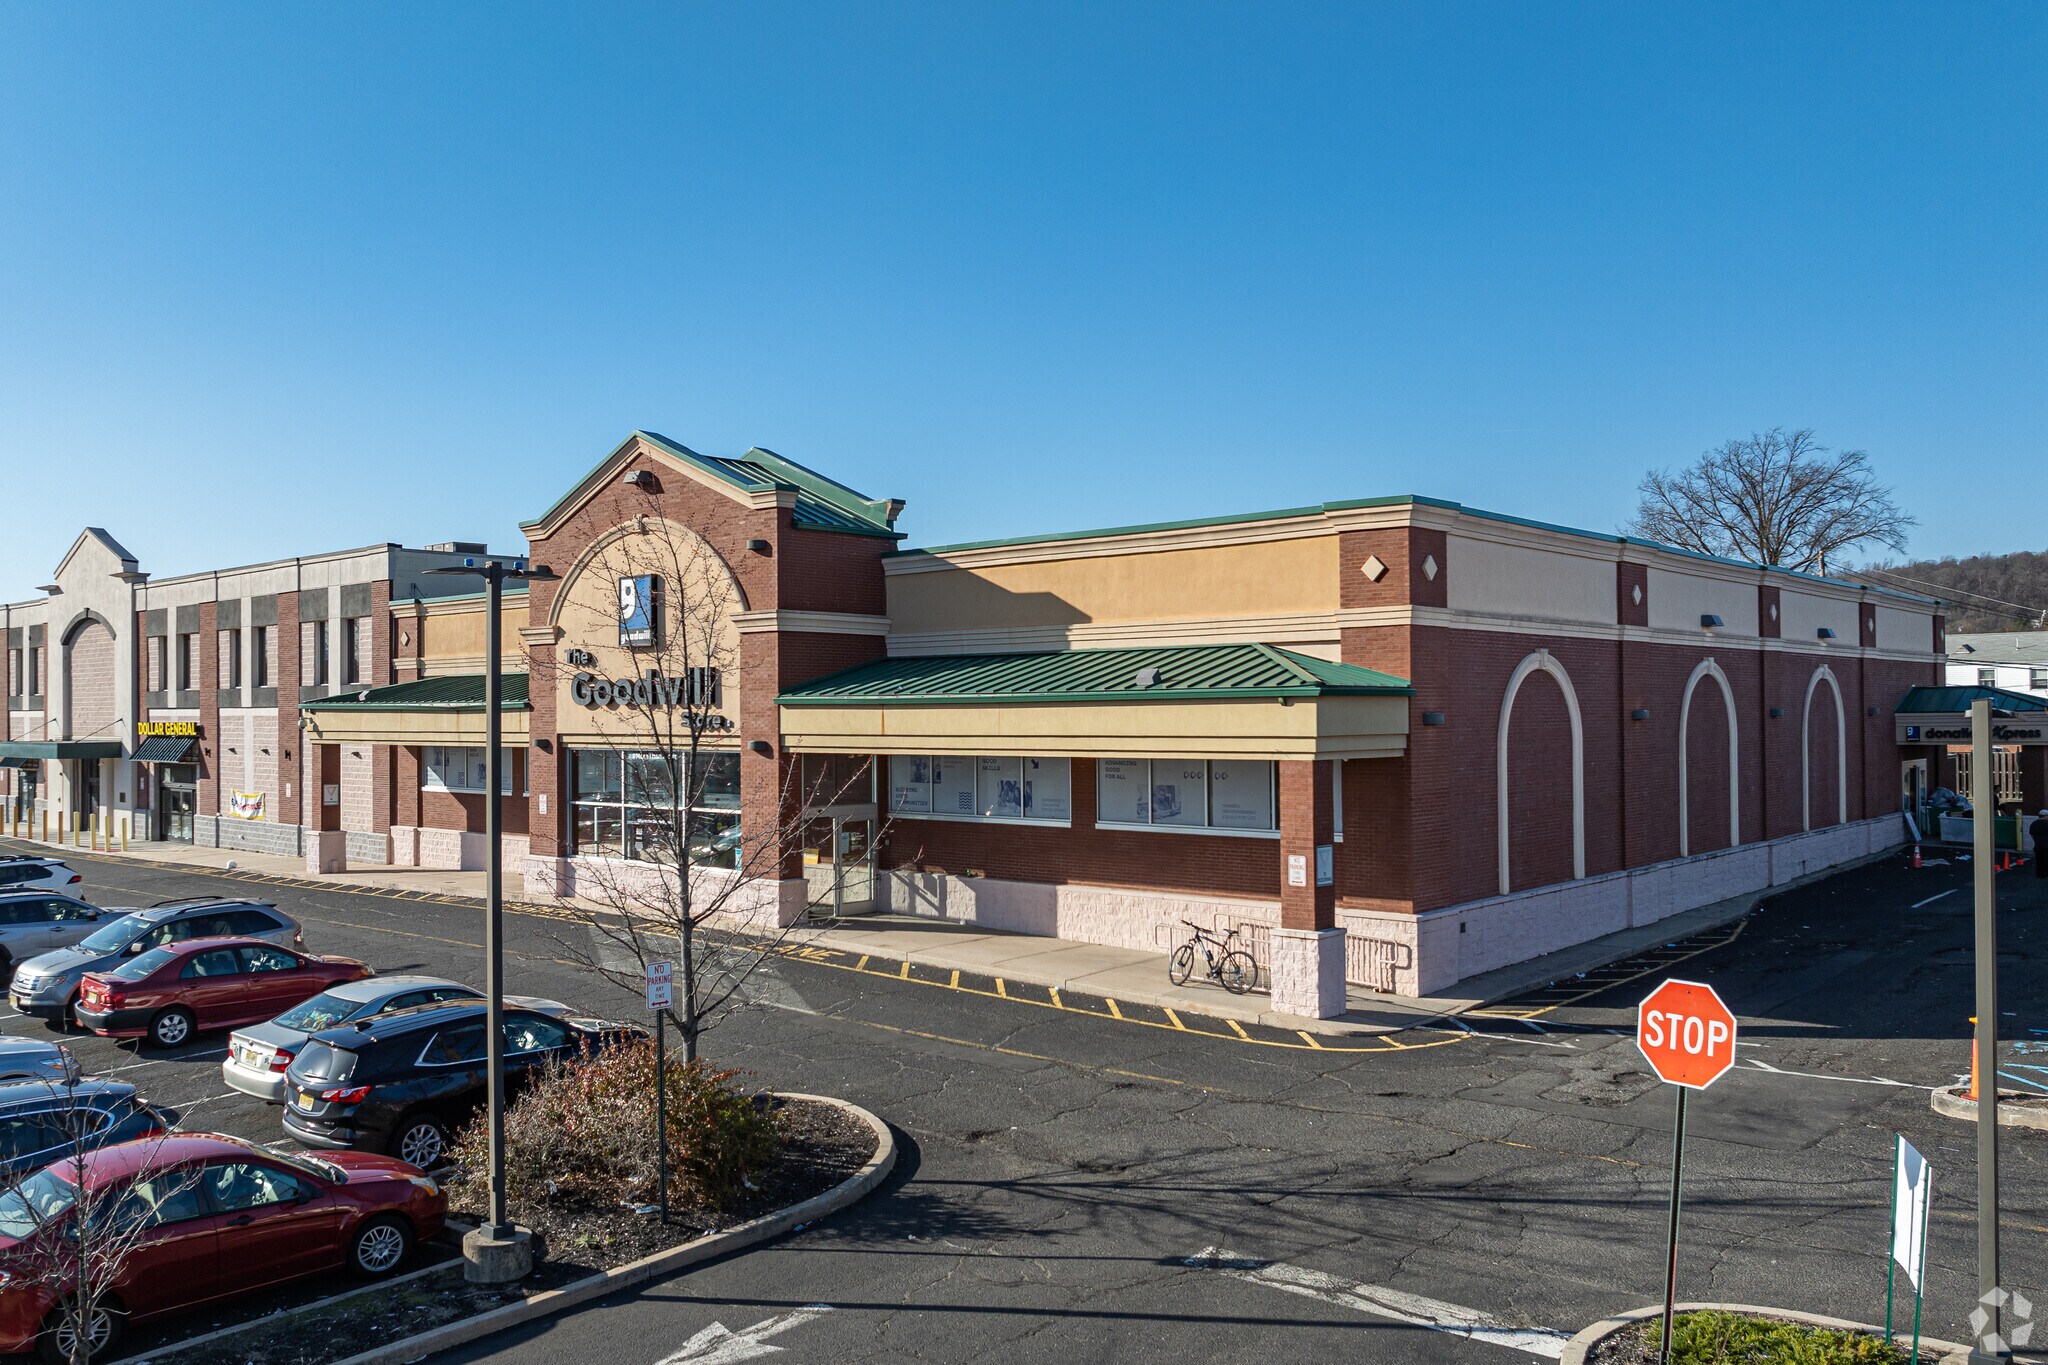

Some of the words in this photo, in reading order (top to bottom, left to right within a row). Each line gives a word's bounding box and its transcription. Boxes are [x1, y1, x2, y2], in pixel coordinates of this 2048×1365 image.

[565, 649, 588, 664] The
[571, 667, 713, 706] Goodwill
[682, 712, 721, 729] Store
[138, 722, 164, 735] DOLLAR
[165, 722, 197, 735] GENERAL
[655, 965, 665, 974] NO
[648, 974, 671, 986] PARKING
[1645, 1010, 1728, 1057] STOP
